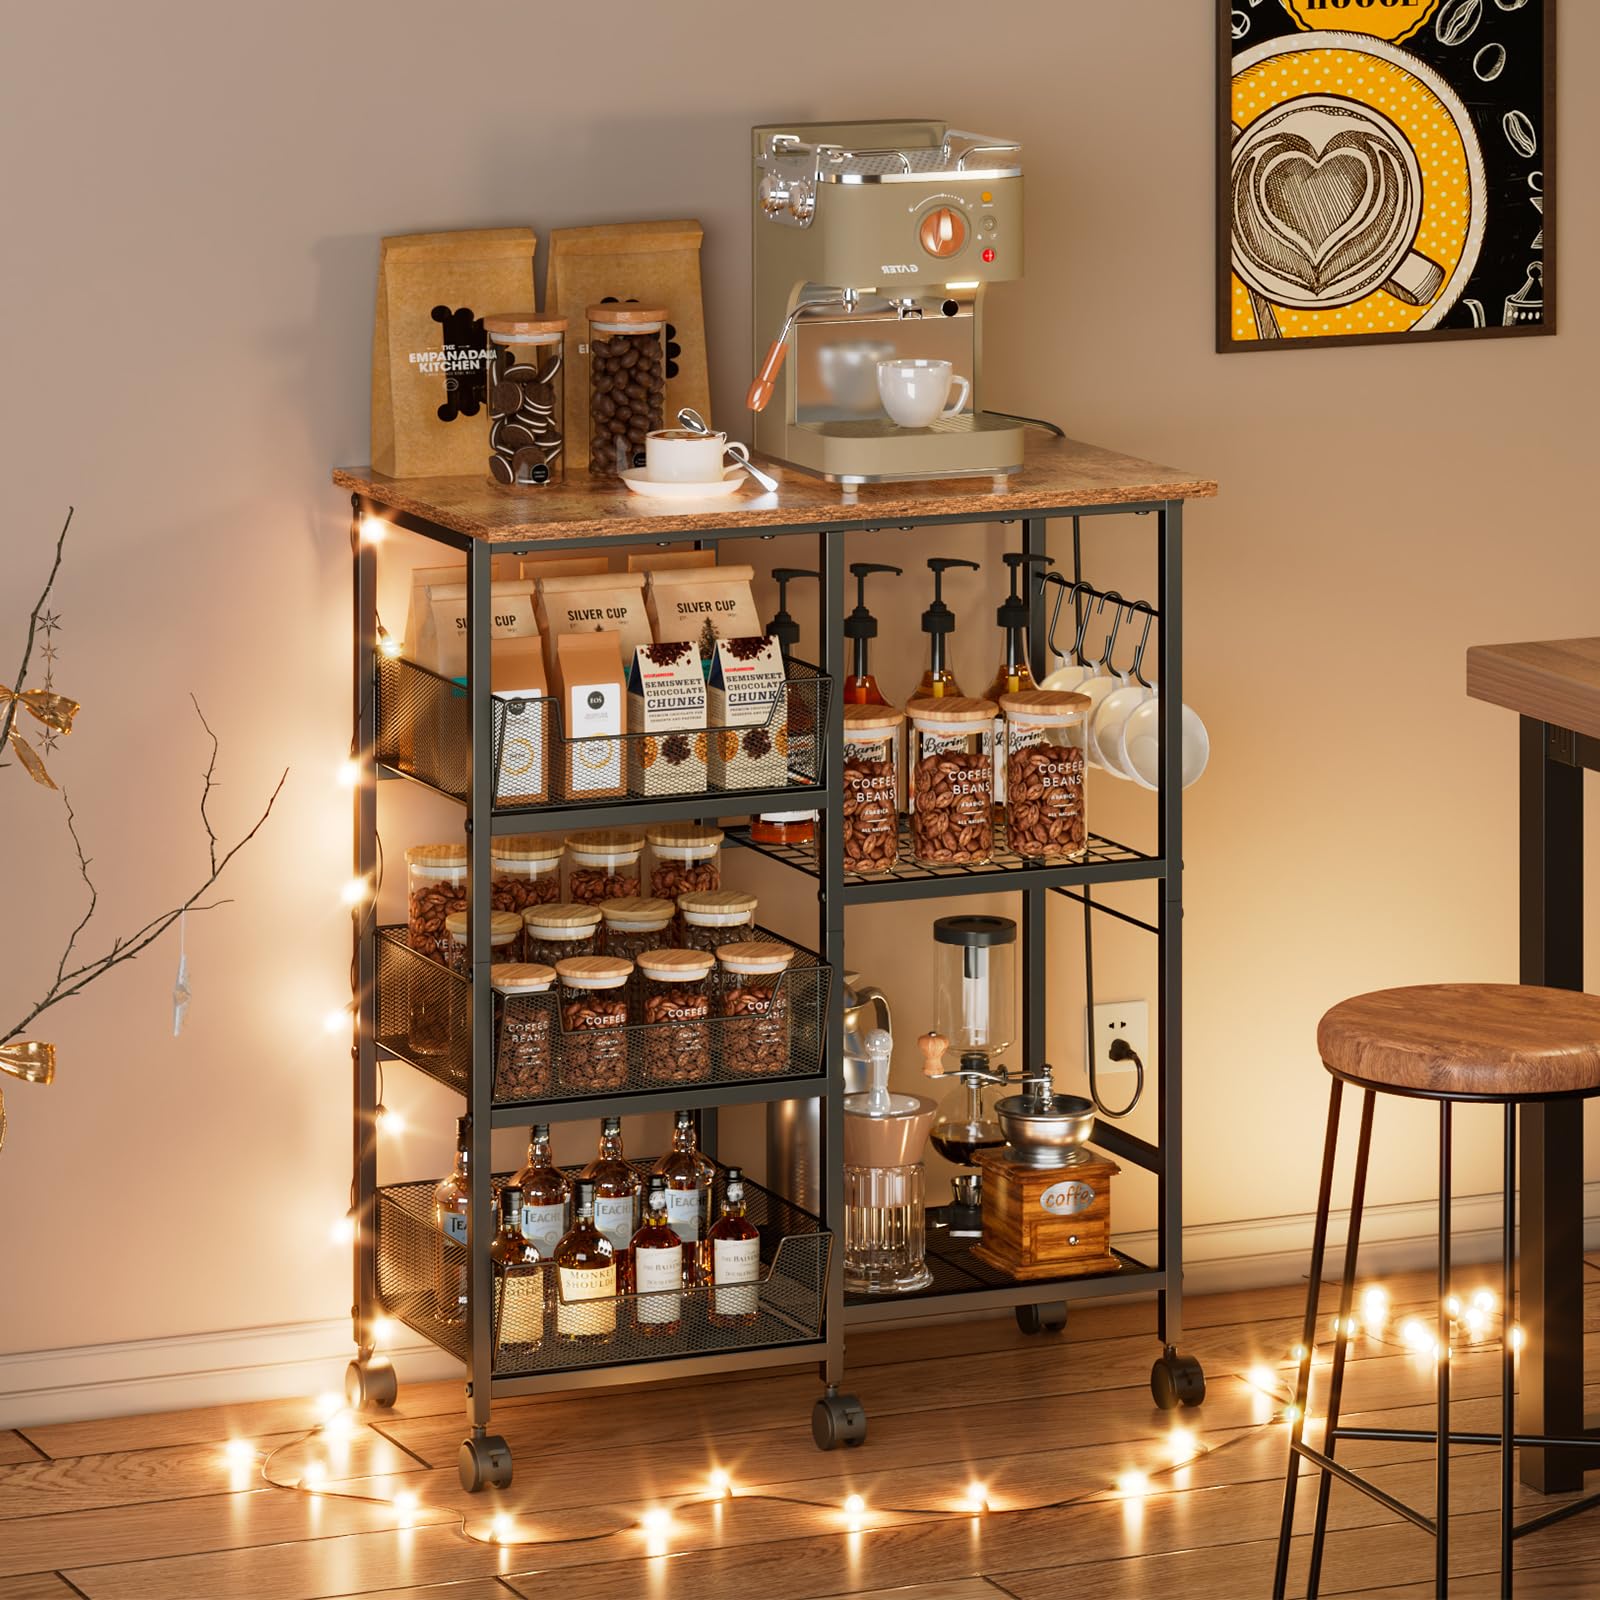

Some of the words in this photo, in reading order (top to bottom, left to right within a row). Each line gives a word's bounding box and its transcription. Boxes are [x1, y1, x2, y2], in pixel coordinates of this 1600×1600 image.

[409, 349, 488, 363] EMPANADA
[419, 360, 480, 373] KITCHEN
[677, 601, 712, 613] SILVER
[715, 600, 736, 611] CUP
[494, 614, 517, 627] CUP
[567, 608, 604, 621] SILVER
[606, 607, 627, 619] CUP
[645, 678, 702, 689] SEMISWEET
[726, 672, 782, 682] SEMISWEET
[646, 687, 704, 697] CHOCOLATE
[727, 681, 780, 691] CHOCOLAT
[647, 695, 705, 709] CHUNKS
[1038, 760, 1084, 774] COFFEE
[948, 767, 992, 781] COFFEE
[852, 776, 895, 789] COFFEE
[1043, 775, 1082, 787] BEANS
[953, 782, 991, 795] BEANS
[857, 789, 895, 802] BEANS
[668, 1006, 708, 1018] COFFEE
[586, 1013, 626, 1026] COFFEE
